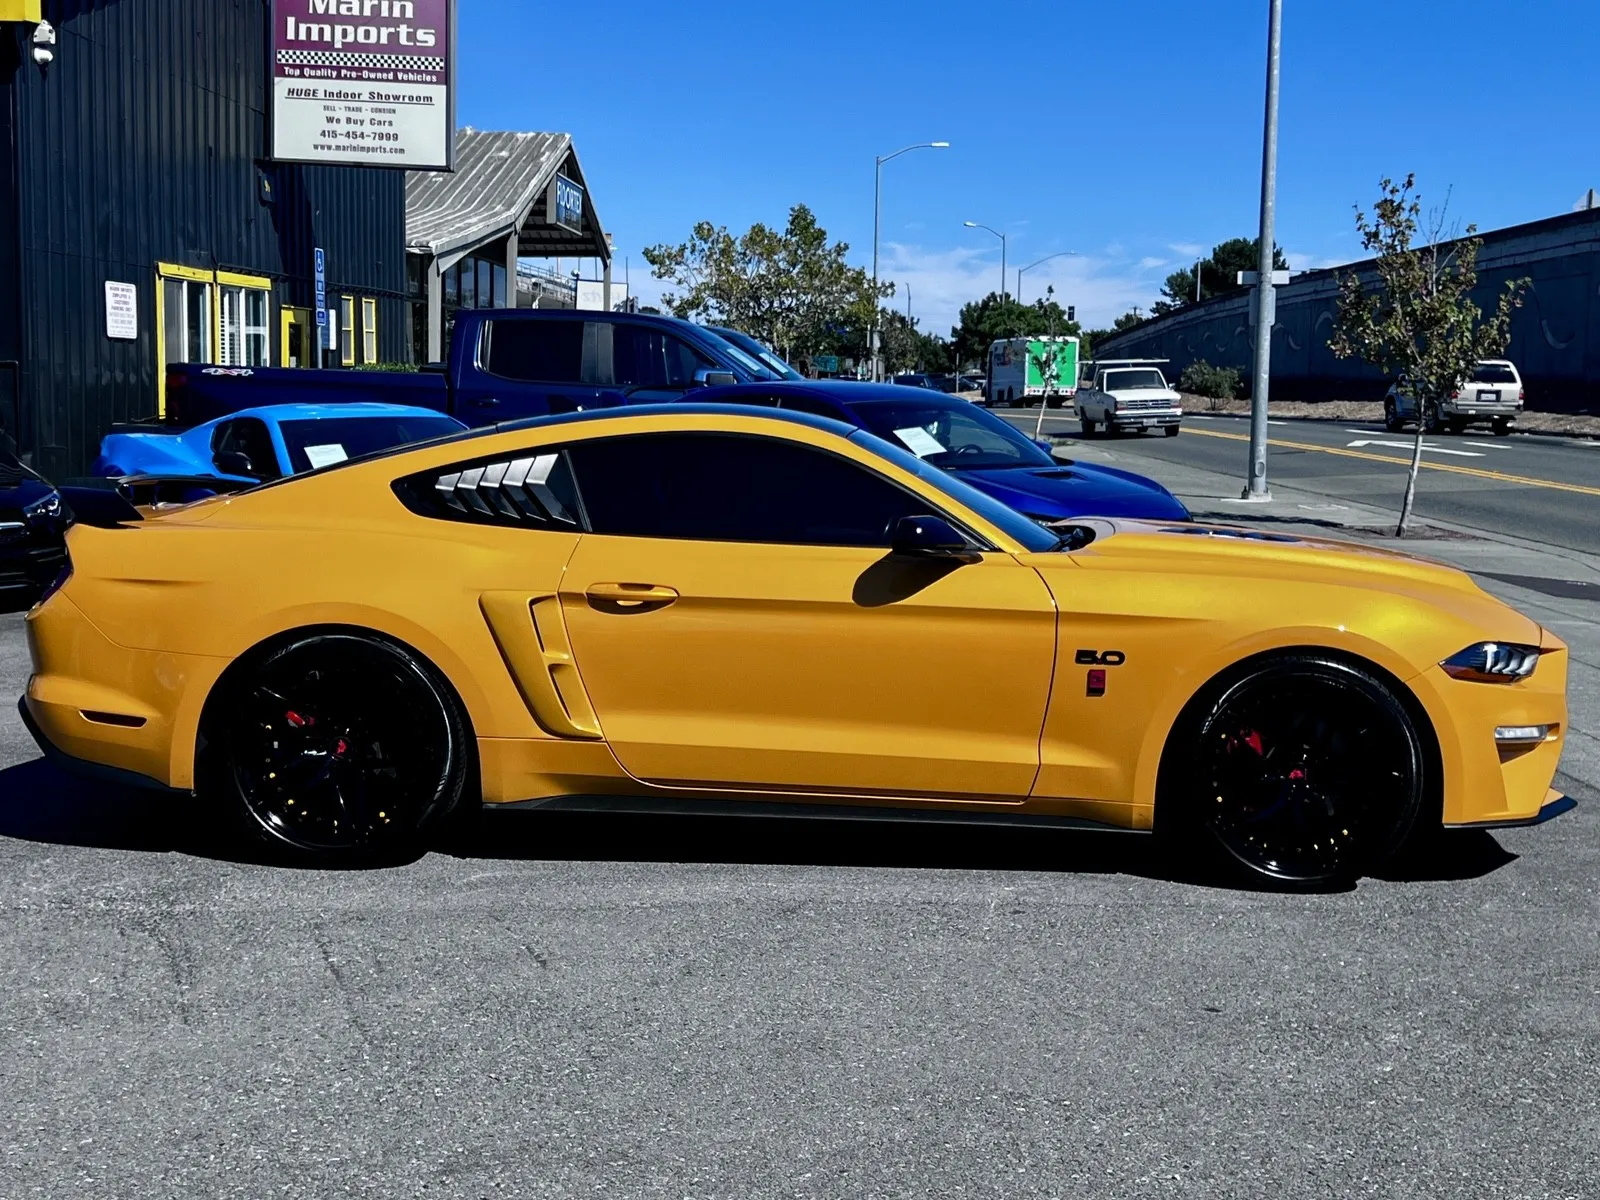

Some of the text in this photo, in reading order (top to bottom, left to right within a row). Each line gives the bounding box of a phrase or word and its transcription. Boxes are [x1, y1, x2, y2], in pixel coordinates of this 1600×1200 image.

[309, 0, 414, 18] Marin
[286, 16, 436, 48] Imports
[284, 67, 437, 83] Top Quality Pre-Owned Vehicles
[287, 88, 433, 103] HUGE Indoor Showroom
[371, 107, 397, 115] CONSIGN
[325, 116, 394, 127] We Buy Cars
[320, 130, 399, 142] 415-454-7999
[313, 144, 406, 155] www.marinimports.com
